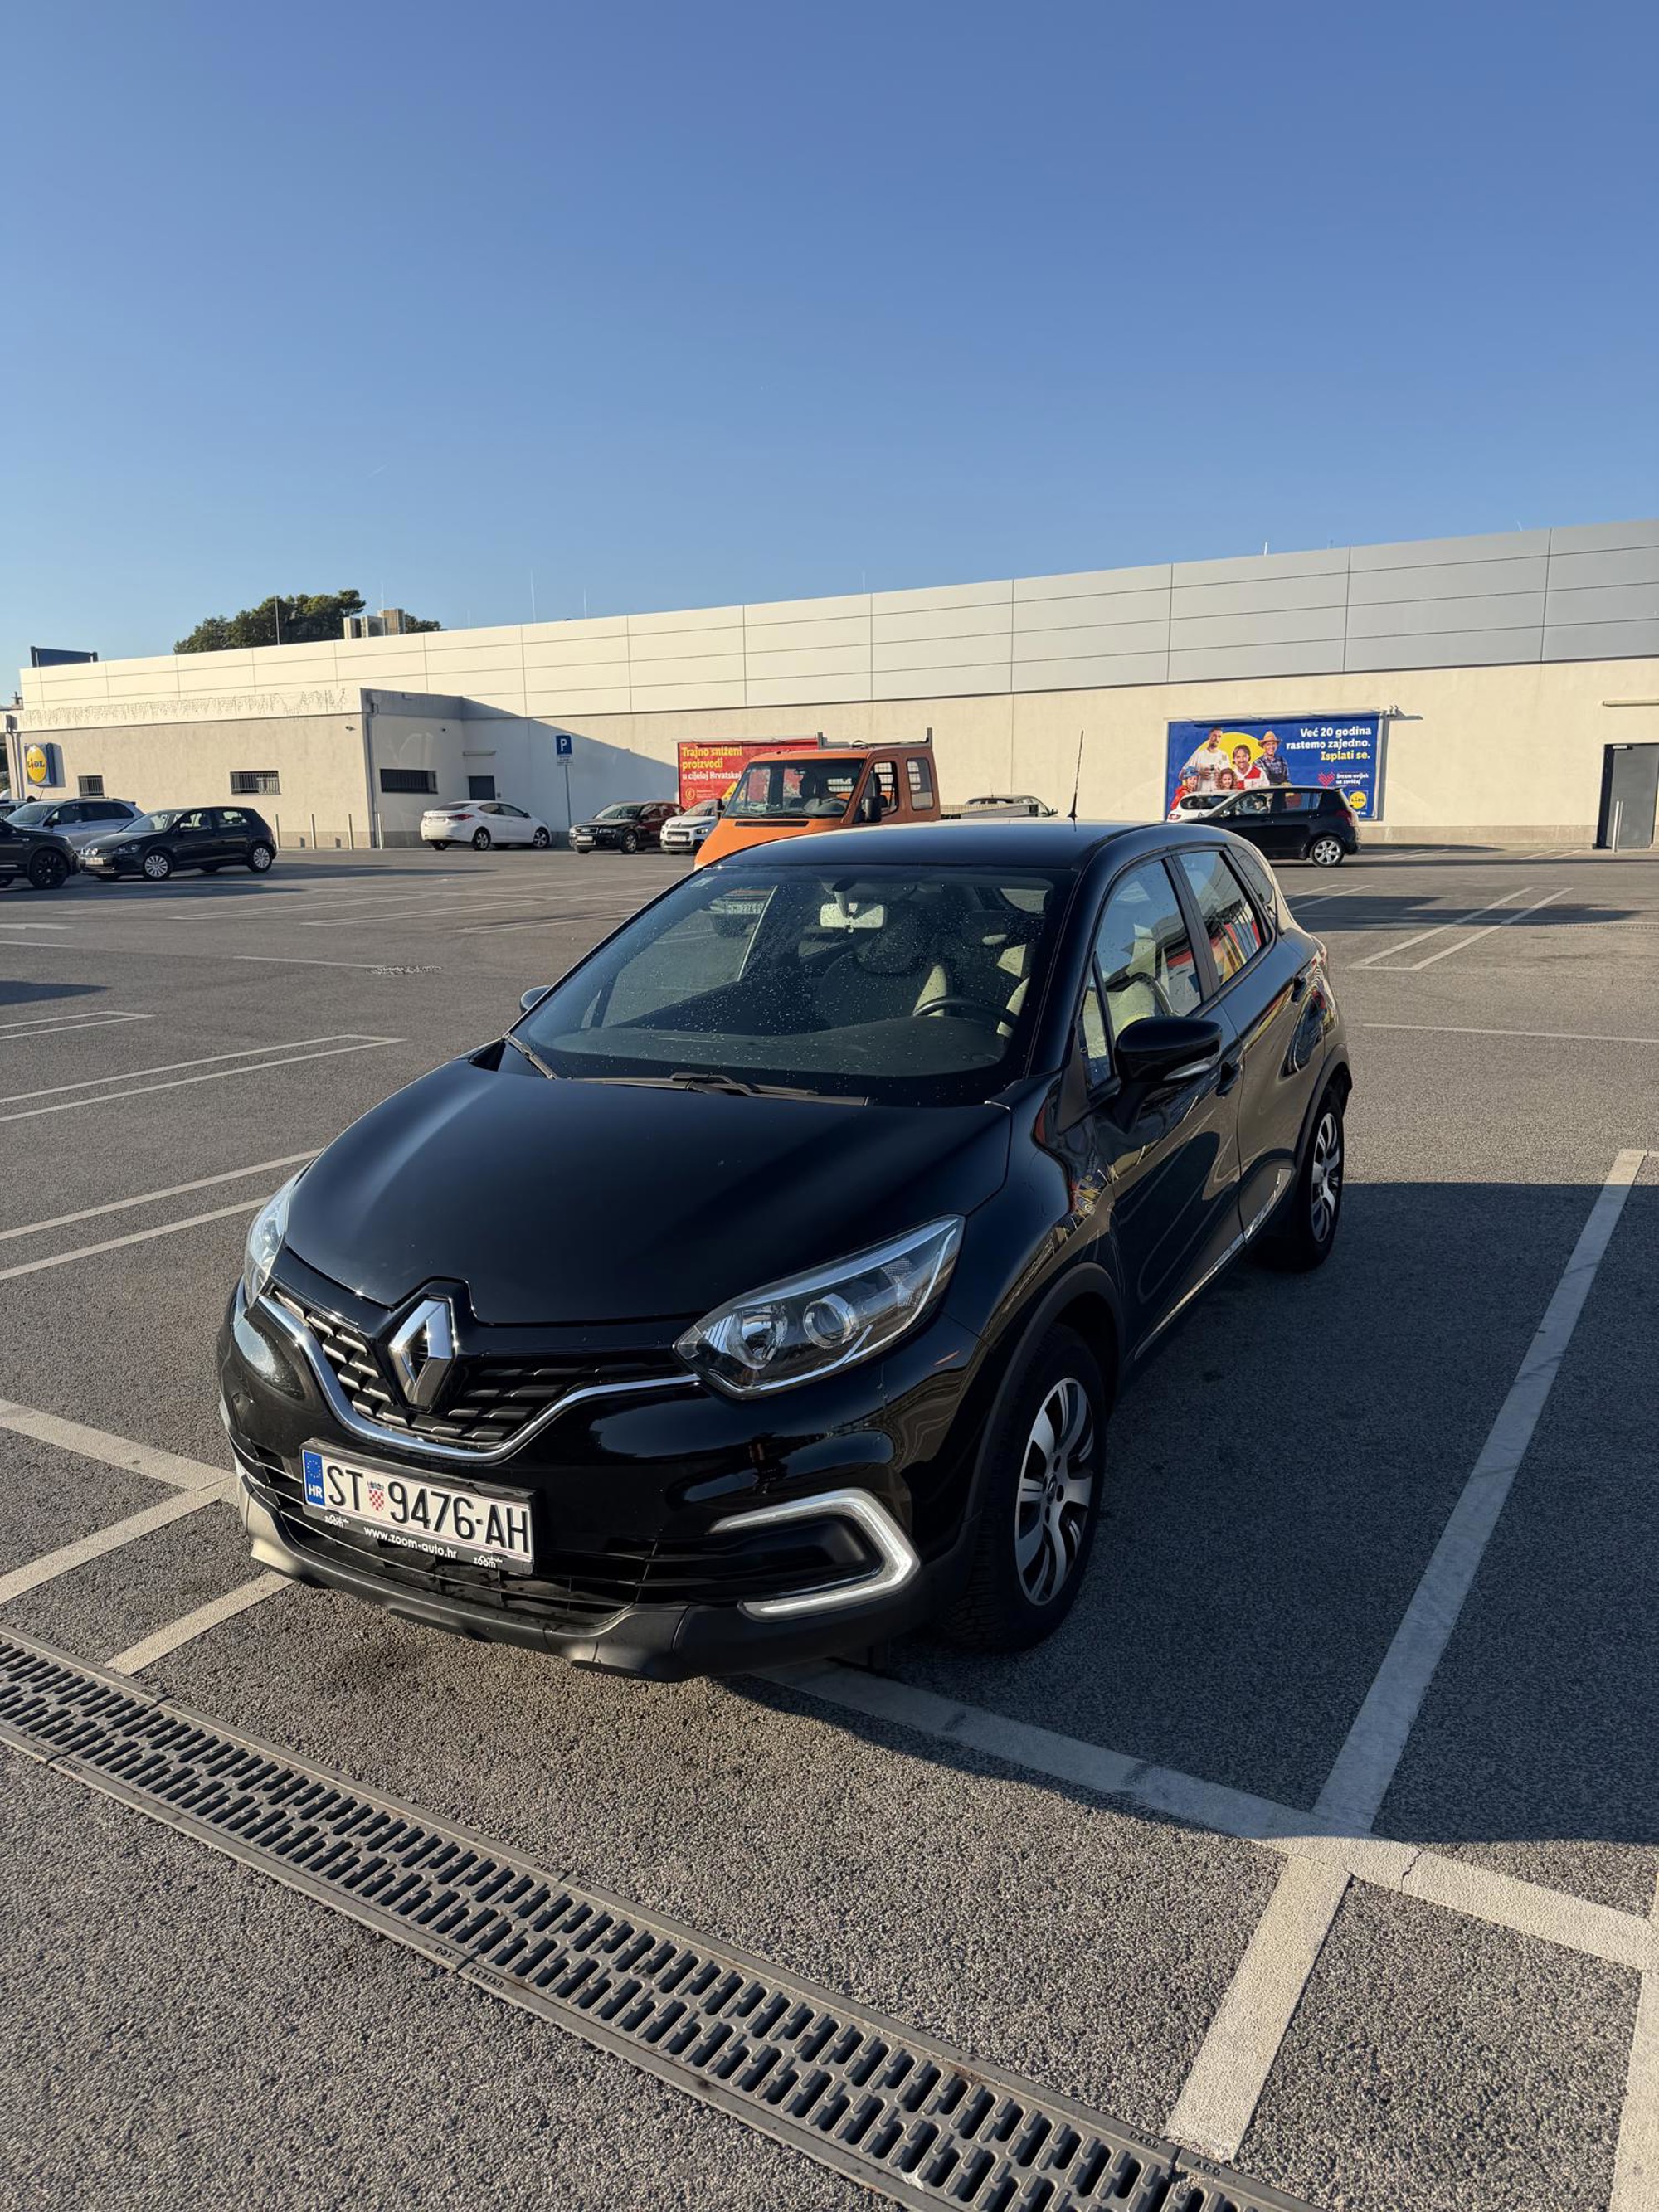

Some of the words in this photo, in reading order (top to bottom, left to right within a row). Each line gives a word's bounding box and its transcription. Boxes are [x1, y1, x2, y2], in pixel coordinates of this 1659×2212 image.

[1300, 727, 1319, 737] Već
[1321, 727, 1334, 737] 20
[1335, 726, 1372, 738] godina
[560, 738, 567, 751] P
[1286, 741, 1326, 750] rastemo
[1328, 738, 1371, 750] zajedno.
[682, 747, 709, 759] Trajno
[711, 746, 743, 756] sniženi
[1321, 750, 1355, 762] Isplati
[682, 757, 724, 771] proizvodi
[688, 772, 708, 781] cijeloj
[308, 1483, 323, 1499] HR
[327, 1465, 363, 1511] ST
[363, 1526, 458, 1559] www.zoom-auto.hr
